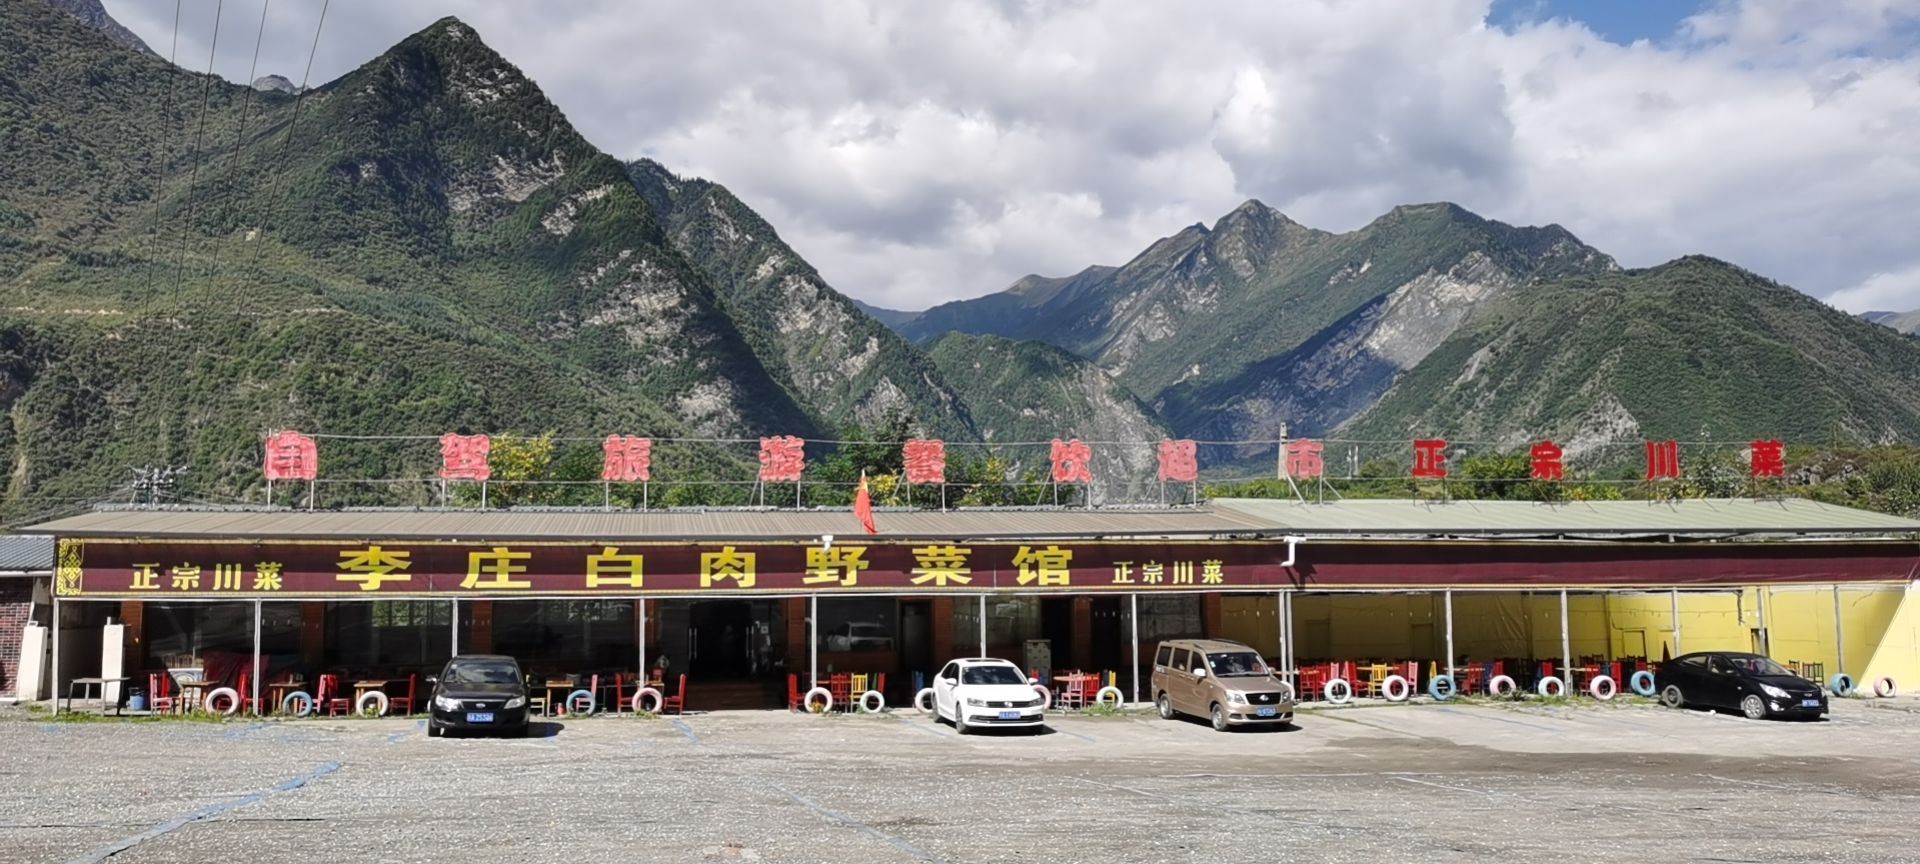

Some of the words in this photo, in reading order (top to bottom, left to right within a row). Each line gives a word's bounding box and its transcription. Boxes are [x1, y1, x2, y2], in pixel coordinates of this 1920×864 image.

[130, 562, 283, 591] 正宗川菜
[336, 546, 1073, 591] 李庄白肉野菜馆
[1112, 559, 1225, 585] 正宗川菜
